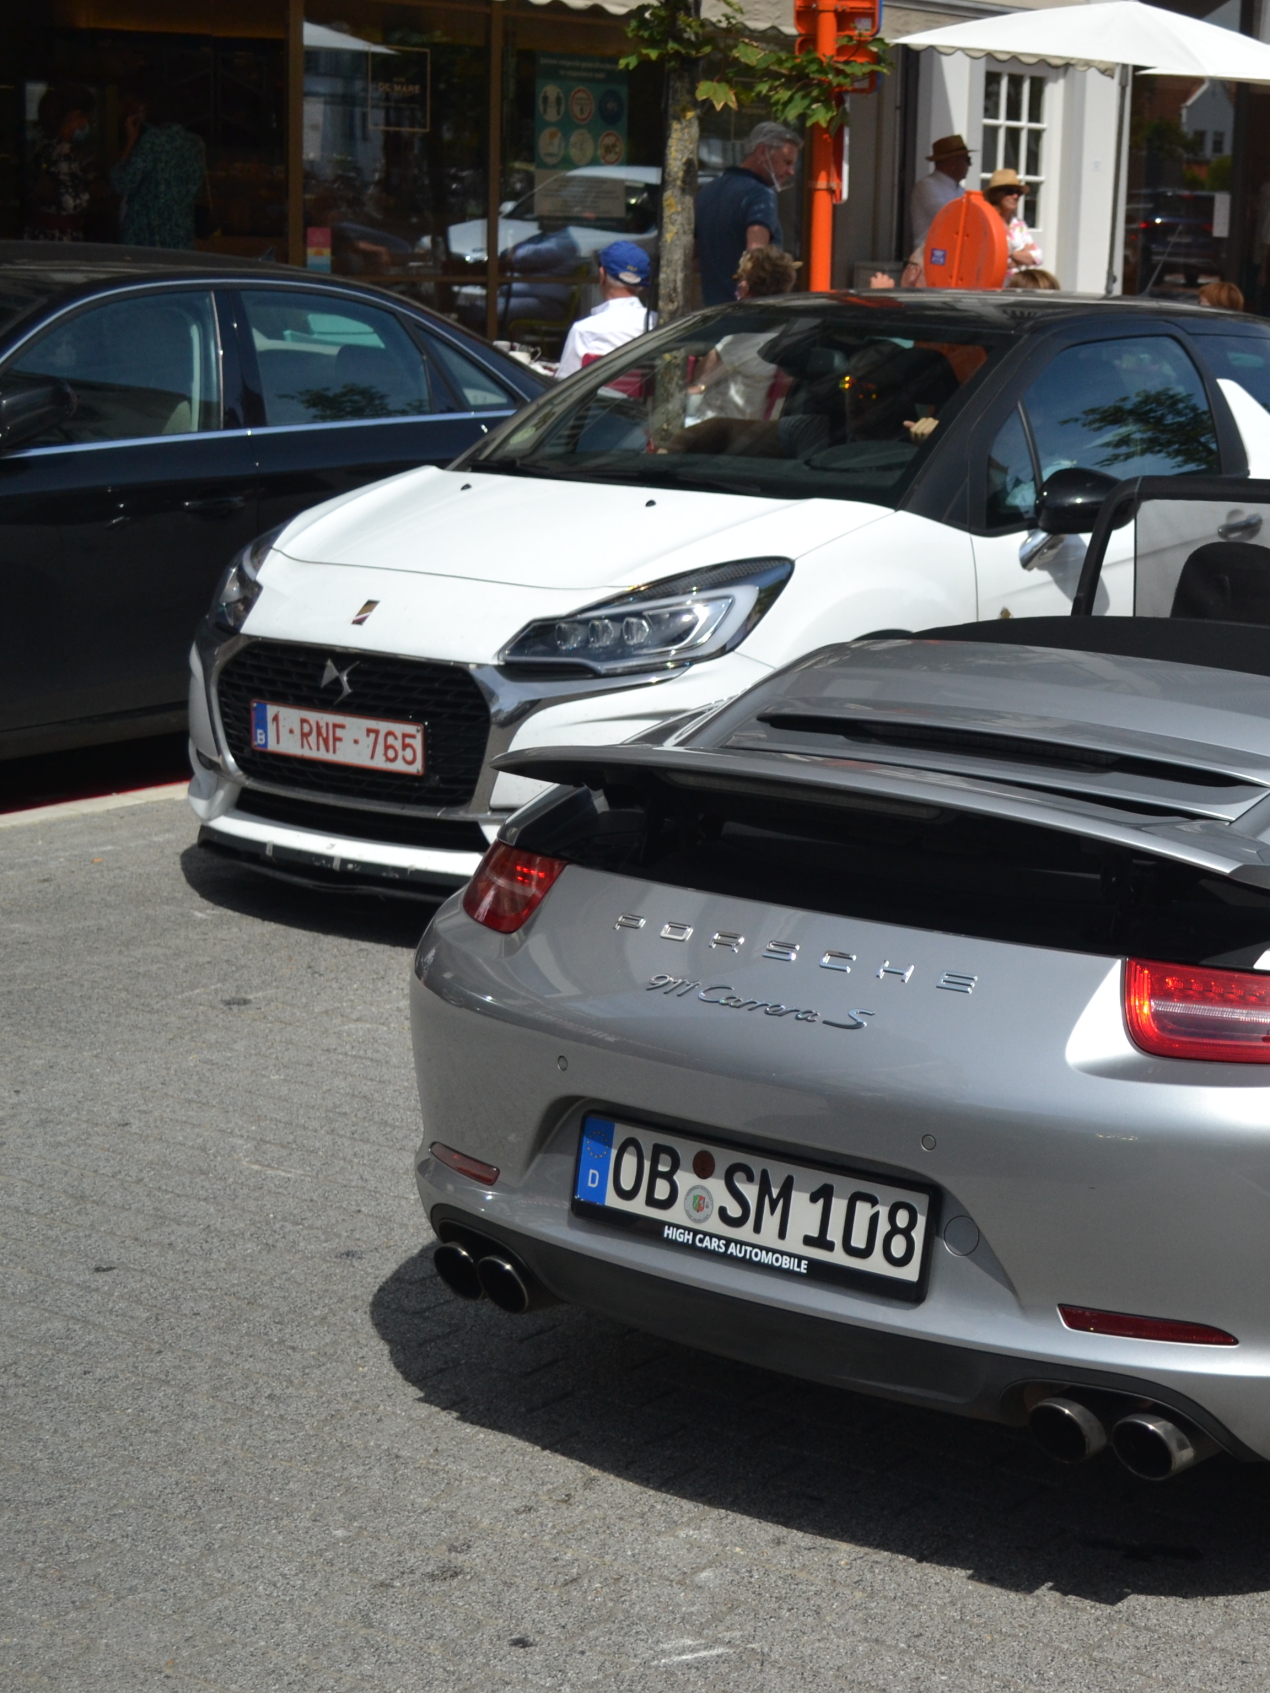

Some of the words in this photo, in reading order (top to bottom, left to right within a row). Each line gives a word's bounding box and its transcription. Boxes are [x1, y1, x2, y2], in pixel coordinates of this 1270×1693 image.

[256, 729, 265, 745] B
[613, 912, 978, 994] PORSCHE
[646, 973, 701, 998] 911
[698, 984, 821, 1023] Carrera
[822, 1008, 876, 1030] S
[587, 1168, 600, 1188] D
[612, 1136, 681, 1211] OB
[718, 1162, 795, 1241] SM
[802, 1183, 919, 1268] 108
[663, 1225, 693, 1245] HIGH
[695, 1233, 726, 1254] CARS
[727, 1242, 808, 1273] AUTOMOBILE
